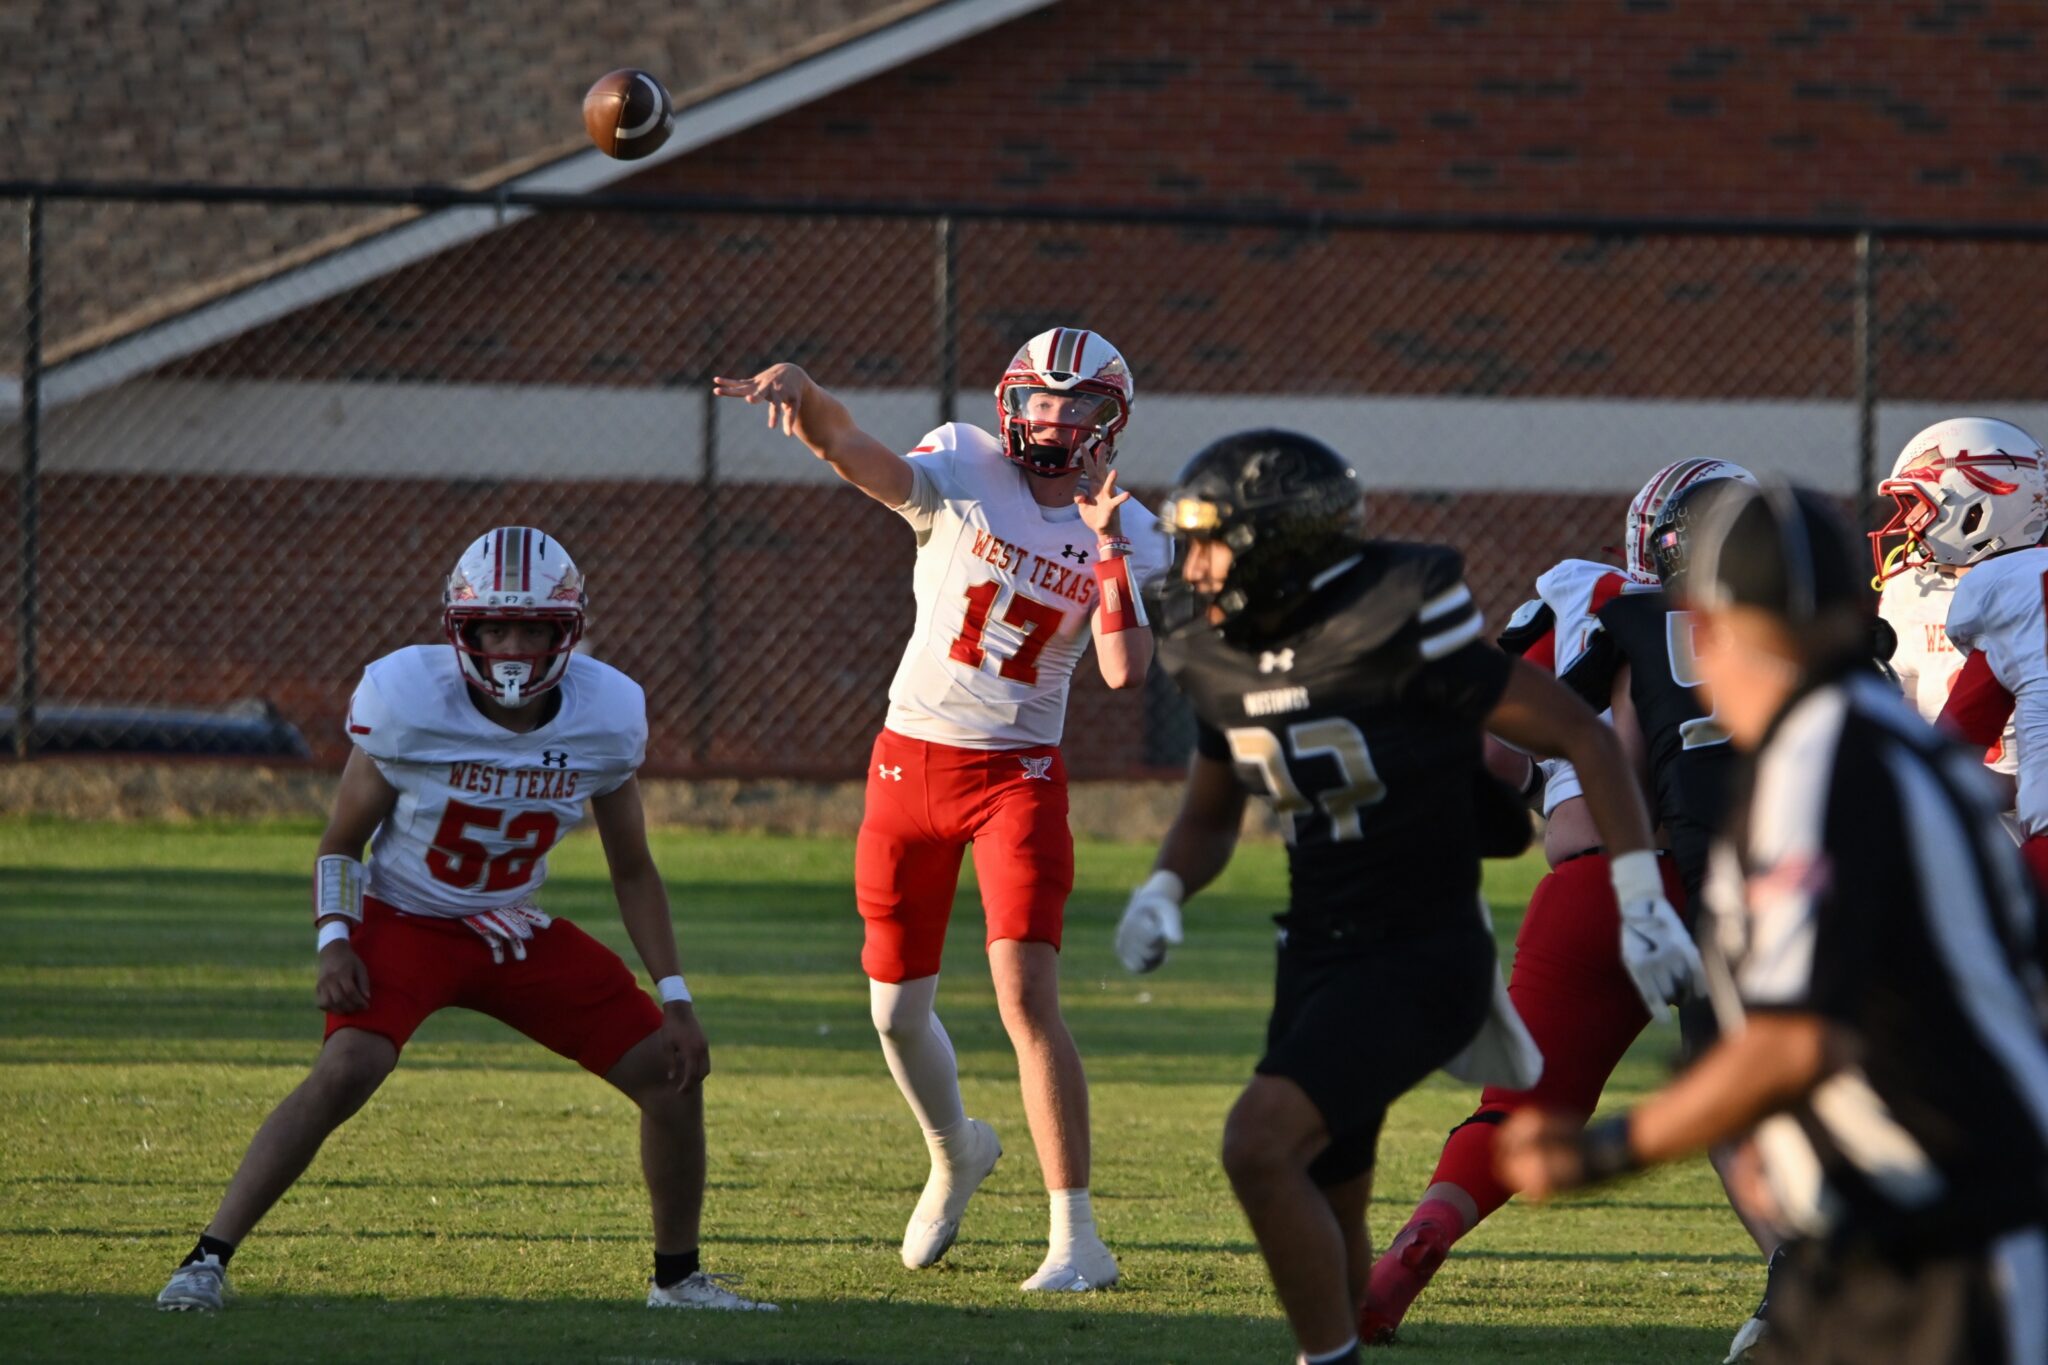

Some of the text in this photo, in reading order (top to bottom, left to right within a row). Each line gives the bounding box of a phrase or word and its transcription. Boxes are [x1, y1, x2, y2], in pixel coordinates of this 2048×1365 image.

[505, 595, 519, 604] F7
[972, 527, 1096, 604] WEST TEXAS
[948, 578, 1066, 687] 17
[449, 762, 580, 799] WEST TEXAS
[425, 797, 560, 892] 52
